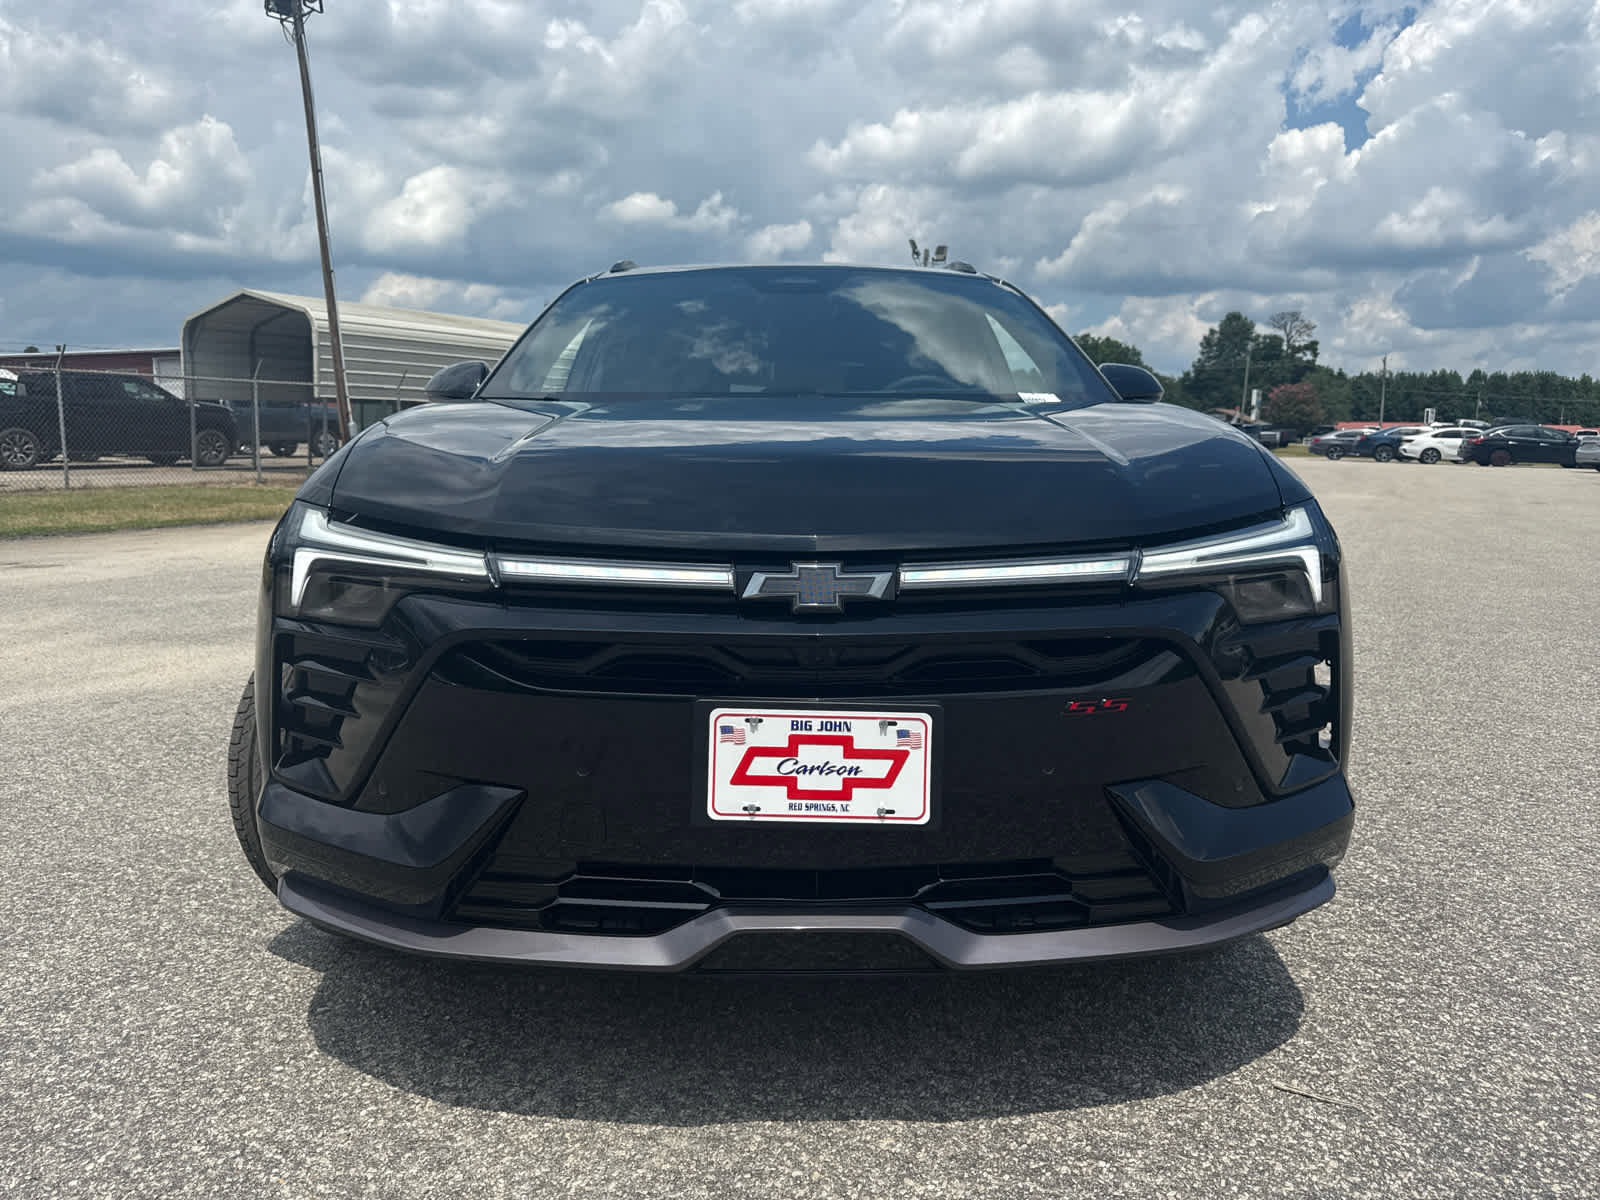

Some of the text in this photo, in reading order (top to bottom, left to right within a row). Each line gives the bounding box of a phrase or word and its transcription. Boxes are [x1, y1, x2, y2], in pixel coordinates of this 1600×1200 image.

[1066, 697, 1129, 714] SS
[790, 719, 852, 732] BIG JOHN
[776, 757, 863, 776] Carlson
[788, 802, 850, 813] RED SPRINGS, NC
